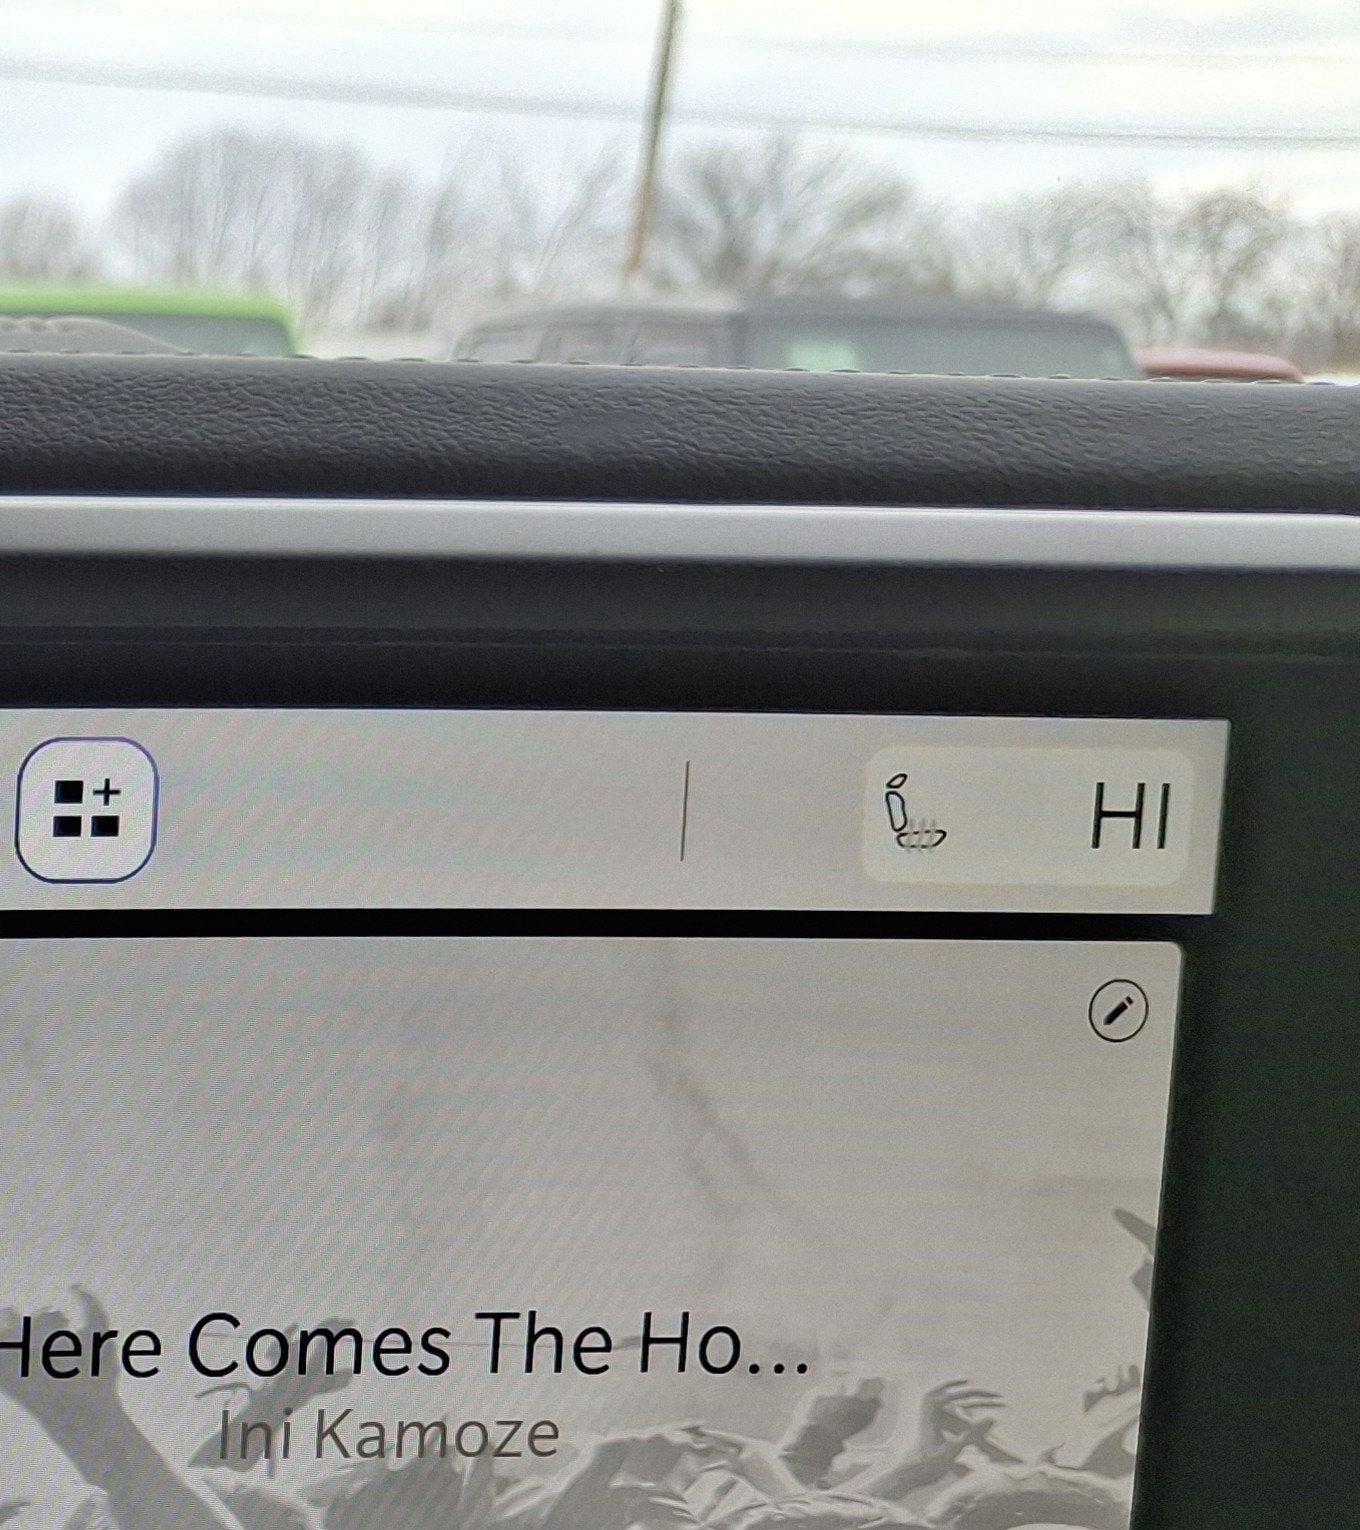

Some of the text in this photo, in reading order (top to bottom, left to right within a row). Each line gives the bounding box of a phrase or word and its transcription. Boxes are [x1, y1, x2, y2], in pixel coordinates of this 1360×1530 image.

[1091, 780, 1172, 851] HI
[186, 1311, 452, 1377] Comes
[473, 1309, 614, 1375] The
[639, 1309, 810, 1375] Ho...
[218, 1405, 561, 1462] Ini Kamoze
